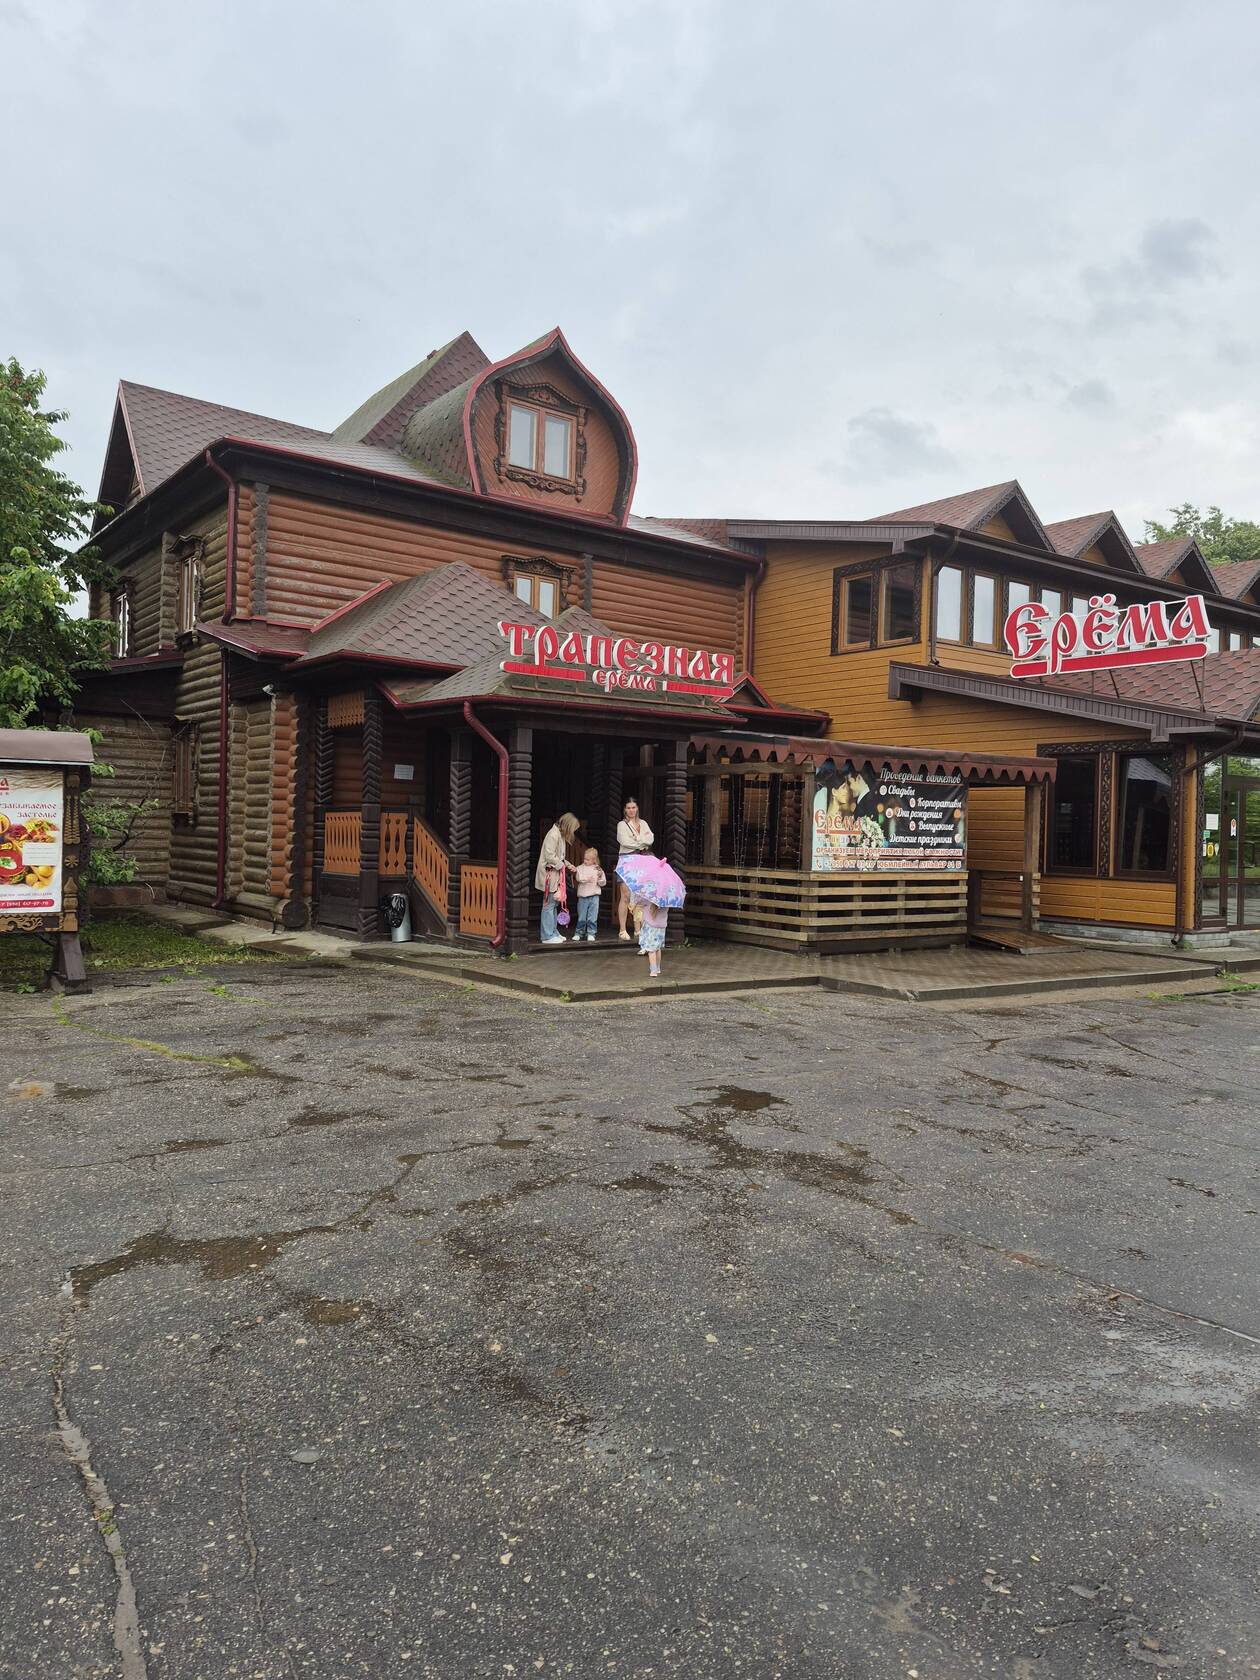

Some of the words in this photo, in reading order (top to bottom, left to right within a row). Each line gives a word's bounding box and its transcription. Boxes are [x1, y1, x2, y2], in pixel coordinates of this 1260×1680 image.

[1004, 593, 1210, 674] Ерёма
[888, 785, 915, 797] Свадьбы
[917, 797, 962, 809] Корпоративы
[896, 806, 910, 817] Дни
[910, 810, 943, 821] рождения
[918, 820, 954, 833] Выпускные
[890, 833, 917, 843] Детские
[918, 836, 952, 846] праздники
